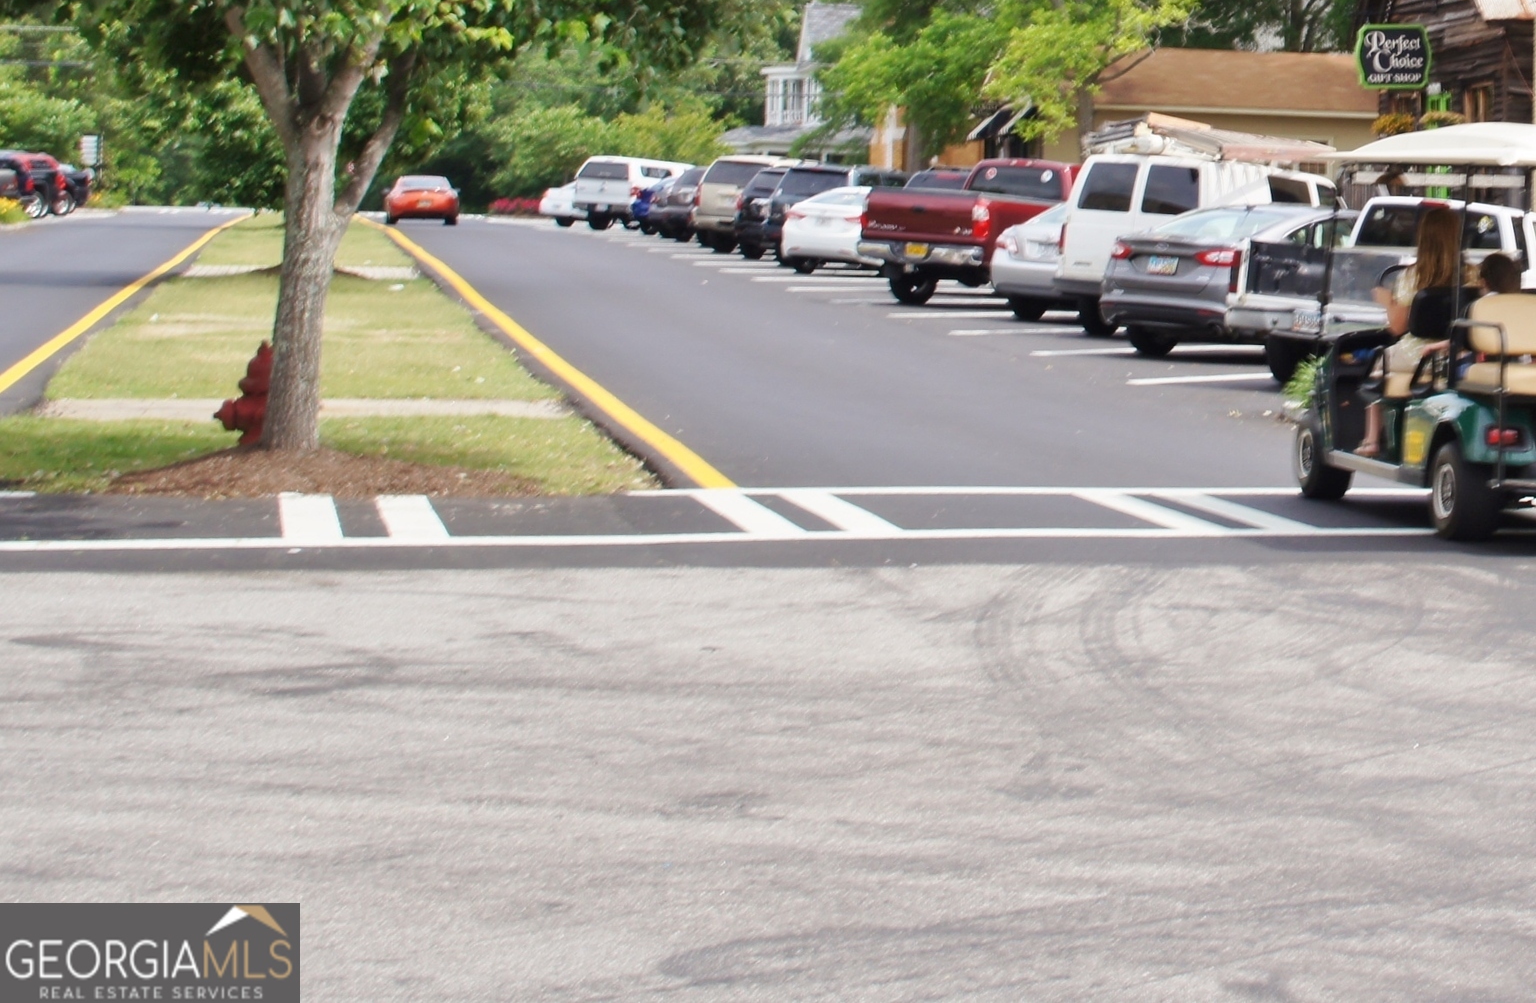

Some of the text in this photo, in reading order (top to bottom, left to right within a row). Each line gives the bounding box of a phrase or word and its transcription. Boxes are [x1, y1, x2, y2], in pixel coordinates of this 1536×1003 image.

[1364, 31, 1421, 59] Perfect
[1373, 48, 1424, 73] Choice
[1367, 73, 1422, 83] GIFT SHOP
